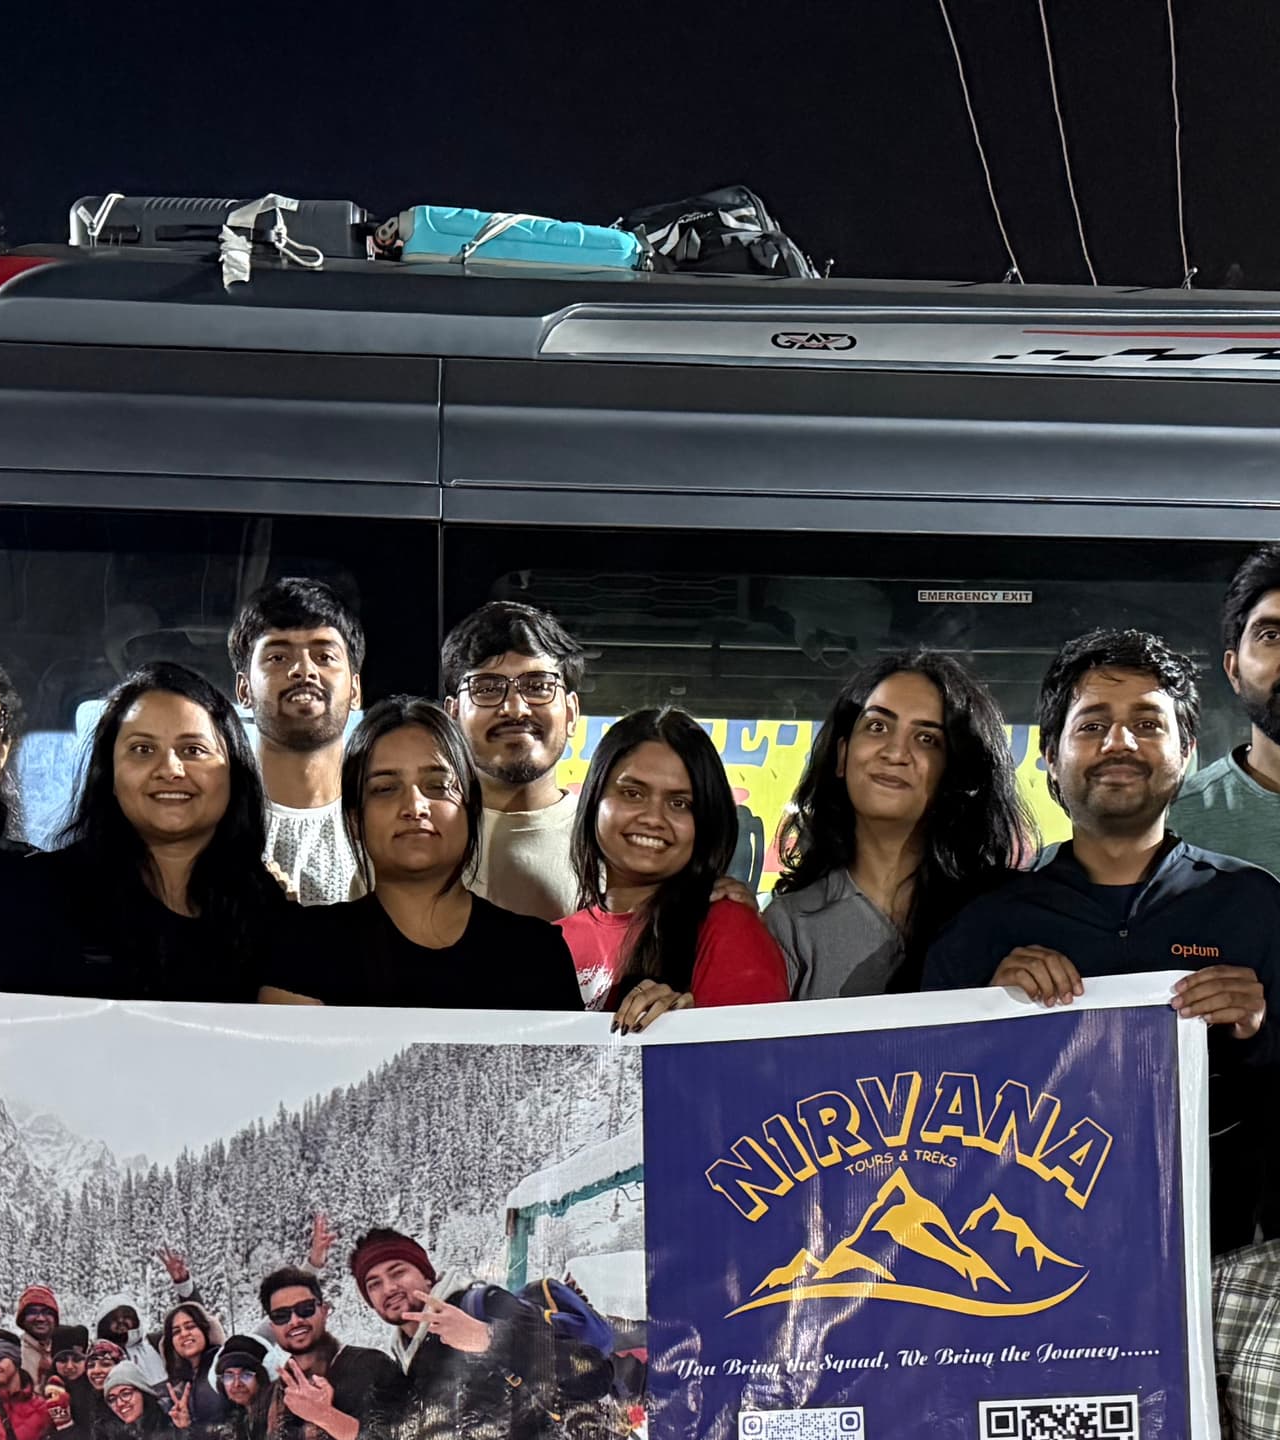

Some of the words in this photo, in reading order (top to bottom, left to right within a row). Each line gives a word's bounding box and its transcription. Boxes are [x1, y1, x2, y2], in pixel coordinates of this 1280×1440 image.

[919, 591, 998, 601] EMERGENCY
[1003, 591, 1032, 601] EXIT
[1171, 944, 1219, 957] Optum
[705, 1071, 1113, 1222] NIRVANA
[844, 1152, 894, 1176] TOURS
[899, 1150, 909, 1161] &
[914, 1150, 958, 1168] TREKS
[673, 1359, 716, 1380] You
[722, 1358, 780, 1377] Bring
[786, 1353, 818, 1373] the
[819, 1351, 889, 1374] Squad,
[897, 1350, 928, 1367] We
[934, 1348, 994, 1368] Bring
[1000, 1345, 1030, 1363] the
